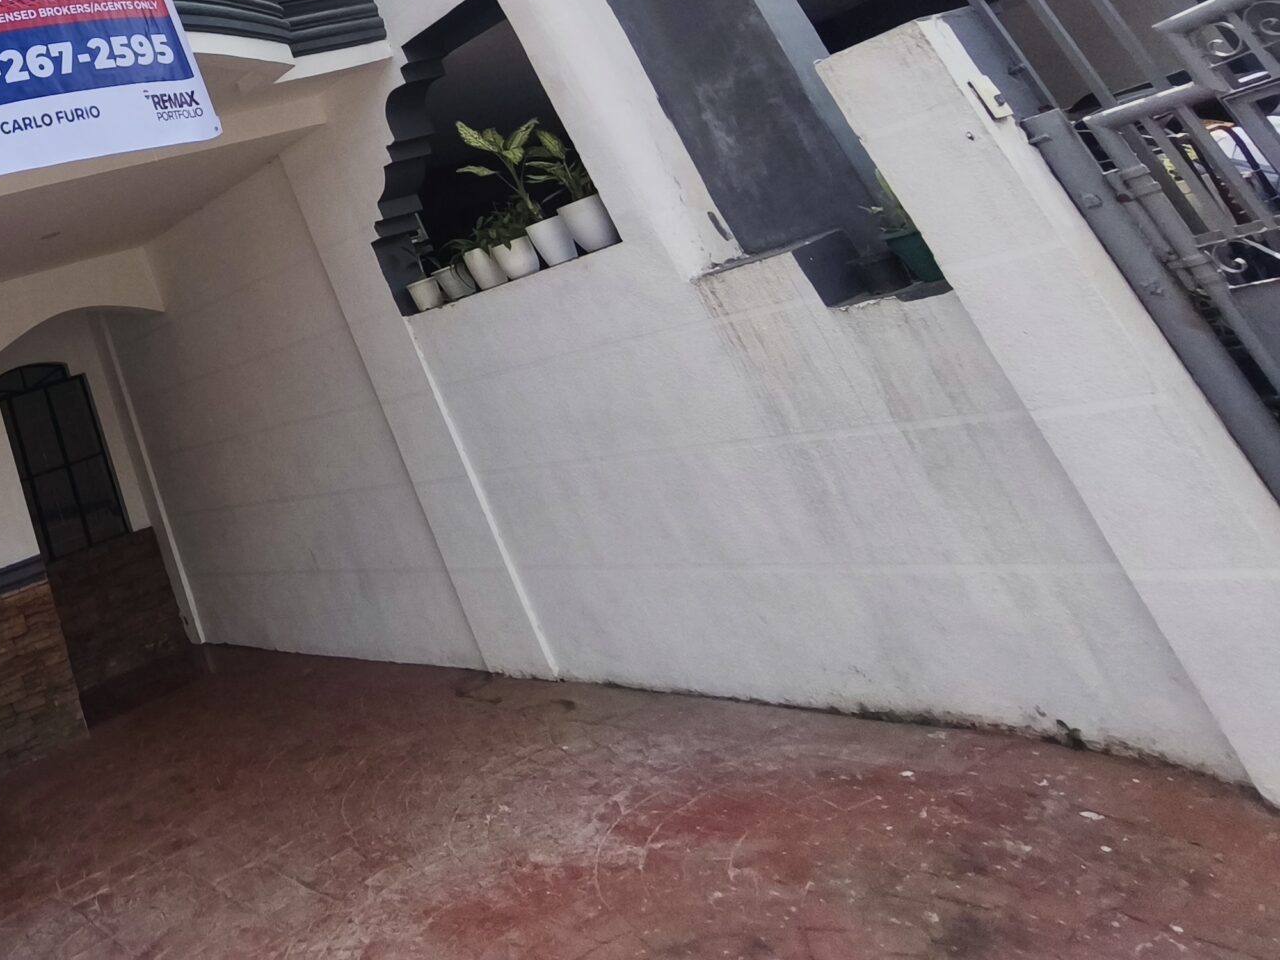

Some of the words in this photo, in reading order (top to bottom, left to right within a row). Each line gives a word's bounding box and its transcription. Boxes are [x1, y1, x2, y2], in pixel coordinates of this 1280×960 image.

[37, 1, 134, 18] BROKERS/AGENTS
[133, 0, 158, 11] ONLY
[0, 113, 53, 135] CARLO
[55, 105, 101, 124] FURIO
[156, 107, 204, 121] PORTFOLIO
